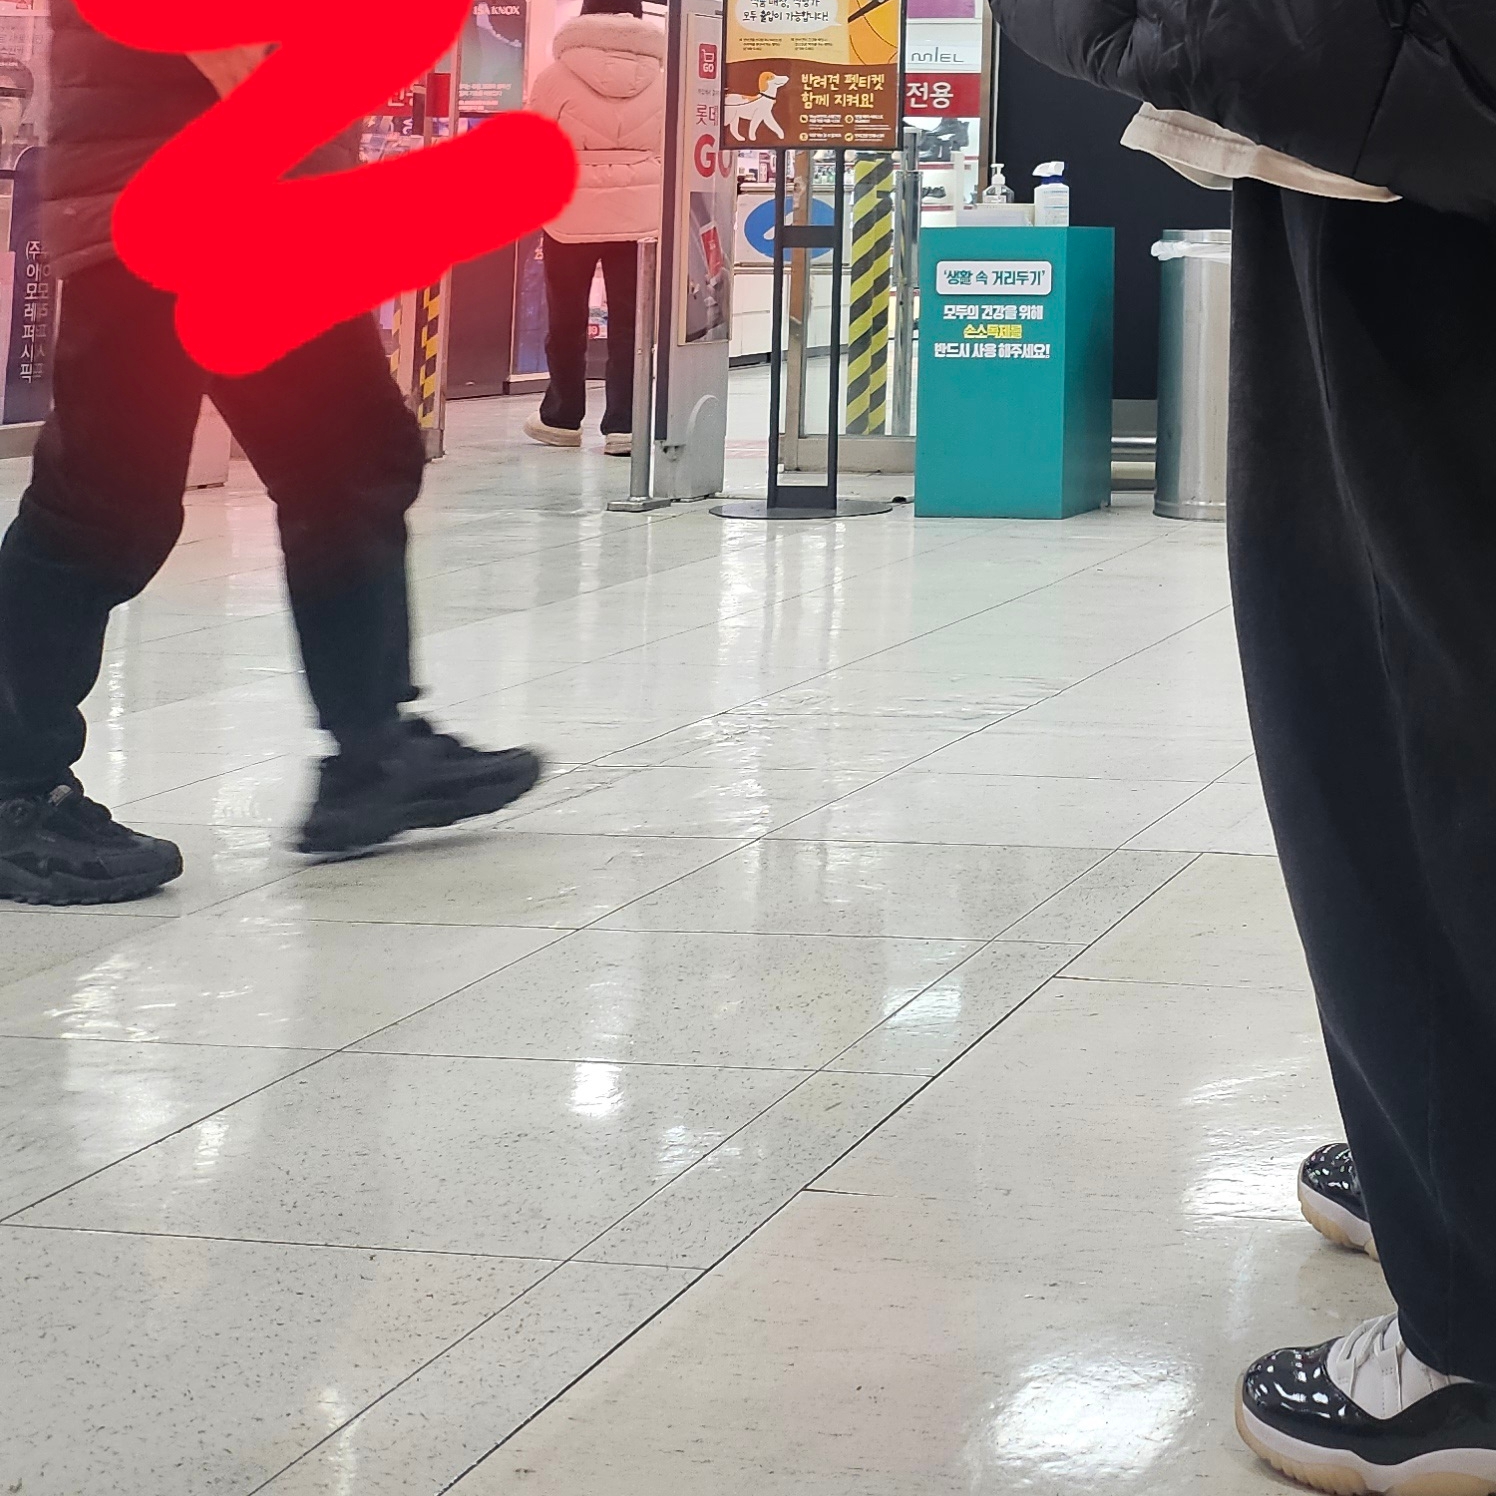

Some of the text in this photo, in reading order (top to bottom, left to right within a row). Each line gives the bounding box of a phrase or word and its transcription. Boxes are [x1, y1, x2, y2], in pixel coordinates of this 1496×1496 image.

[743, 11, 757, 21] 모두
[801, 74, 885, 91] 반려견 펫티켓
[801, 93, 830, 109] 함께
[906, 82, 954, 109] 전용
[976, 271, 988, 285] 속
[943, 305, 1044, 320] 모두의 건강을 위해
[963, 324, 1022, 339] 손소독제를
[934, 343, 1051, 358] 반드시 사용 해주세요!
